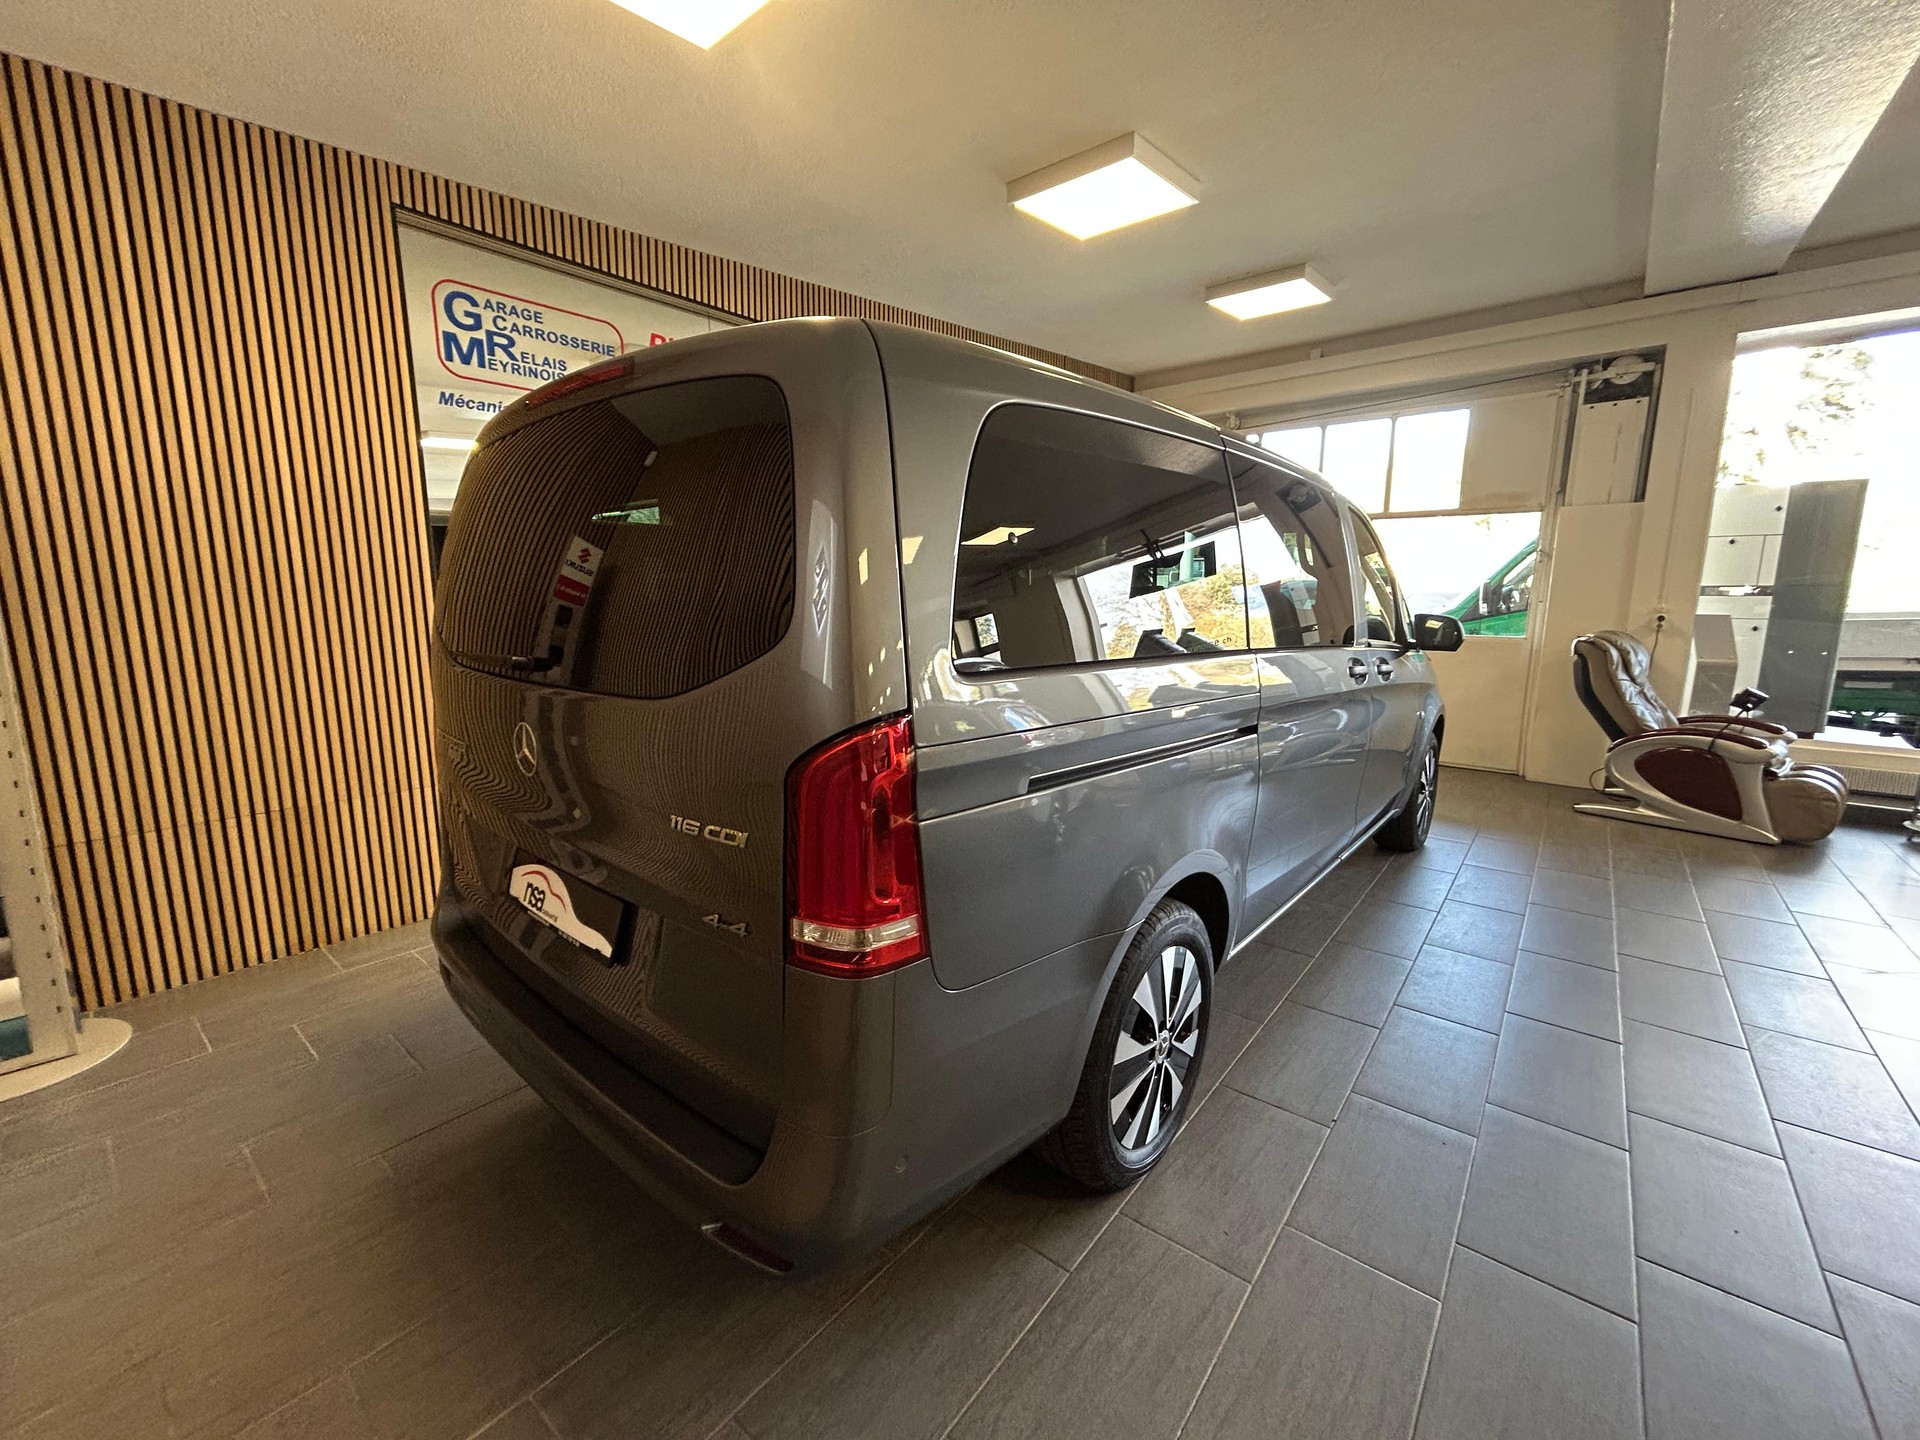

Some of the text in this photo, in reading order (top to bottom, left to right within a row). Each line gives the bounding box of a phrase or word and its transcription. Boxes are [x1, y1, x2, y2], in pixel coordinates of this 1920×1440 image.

[443, 291, 543, 332] GARAGE
[485, 329, 567, 372] RELAIS
[492, 315, 615, 357] CARROSSERIE
[670, 814, 749, 848] 116 CDI
